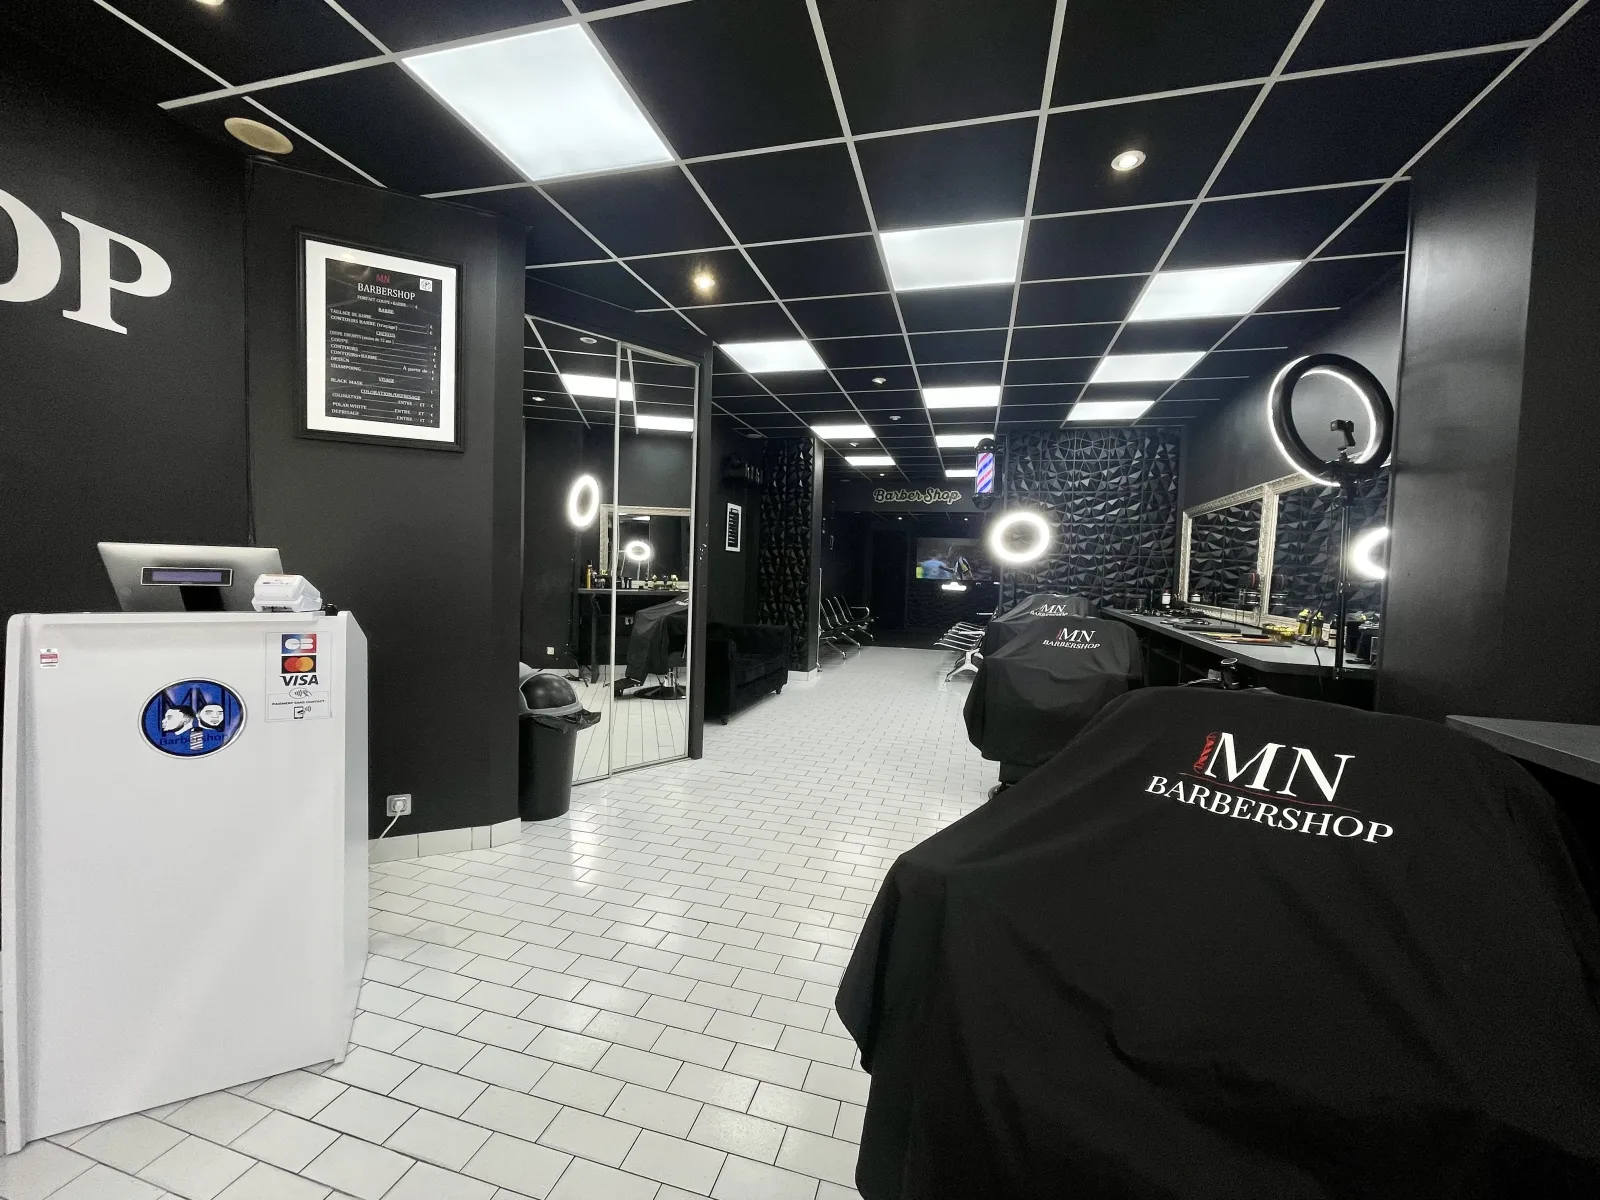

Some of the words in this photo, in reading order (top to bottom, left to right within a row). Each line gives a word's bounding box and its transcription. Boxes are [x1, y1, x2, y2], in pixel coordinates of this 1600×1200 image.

[358, 283, 415, 300] BARBERSHOP
[331, 315, 358, 324] CONTOURS
[873, 488, 923, 503] Barber
[924, 487, 962, 504] Shop
[1041, 604, 1067, 614] MN
[1059, 628, 1096, 642] MN
[1042, 640, 1100, 649] BARBERSHOP
[280, 675, 319, 686] VISA
[1205, 732, 1355, 802] MN
[1144, 776, 1394, 844] BARBERSHOP
